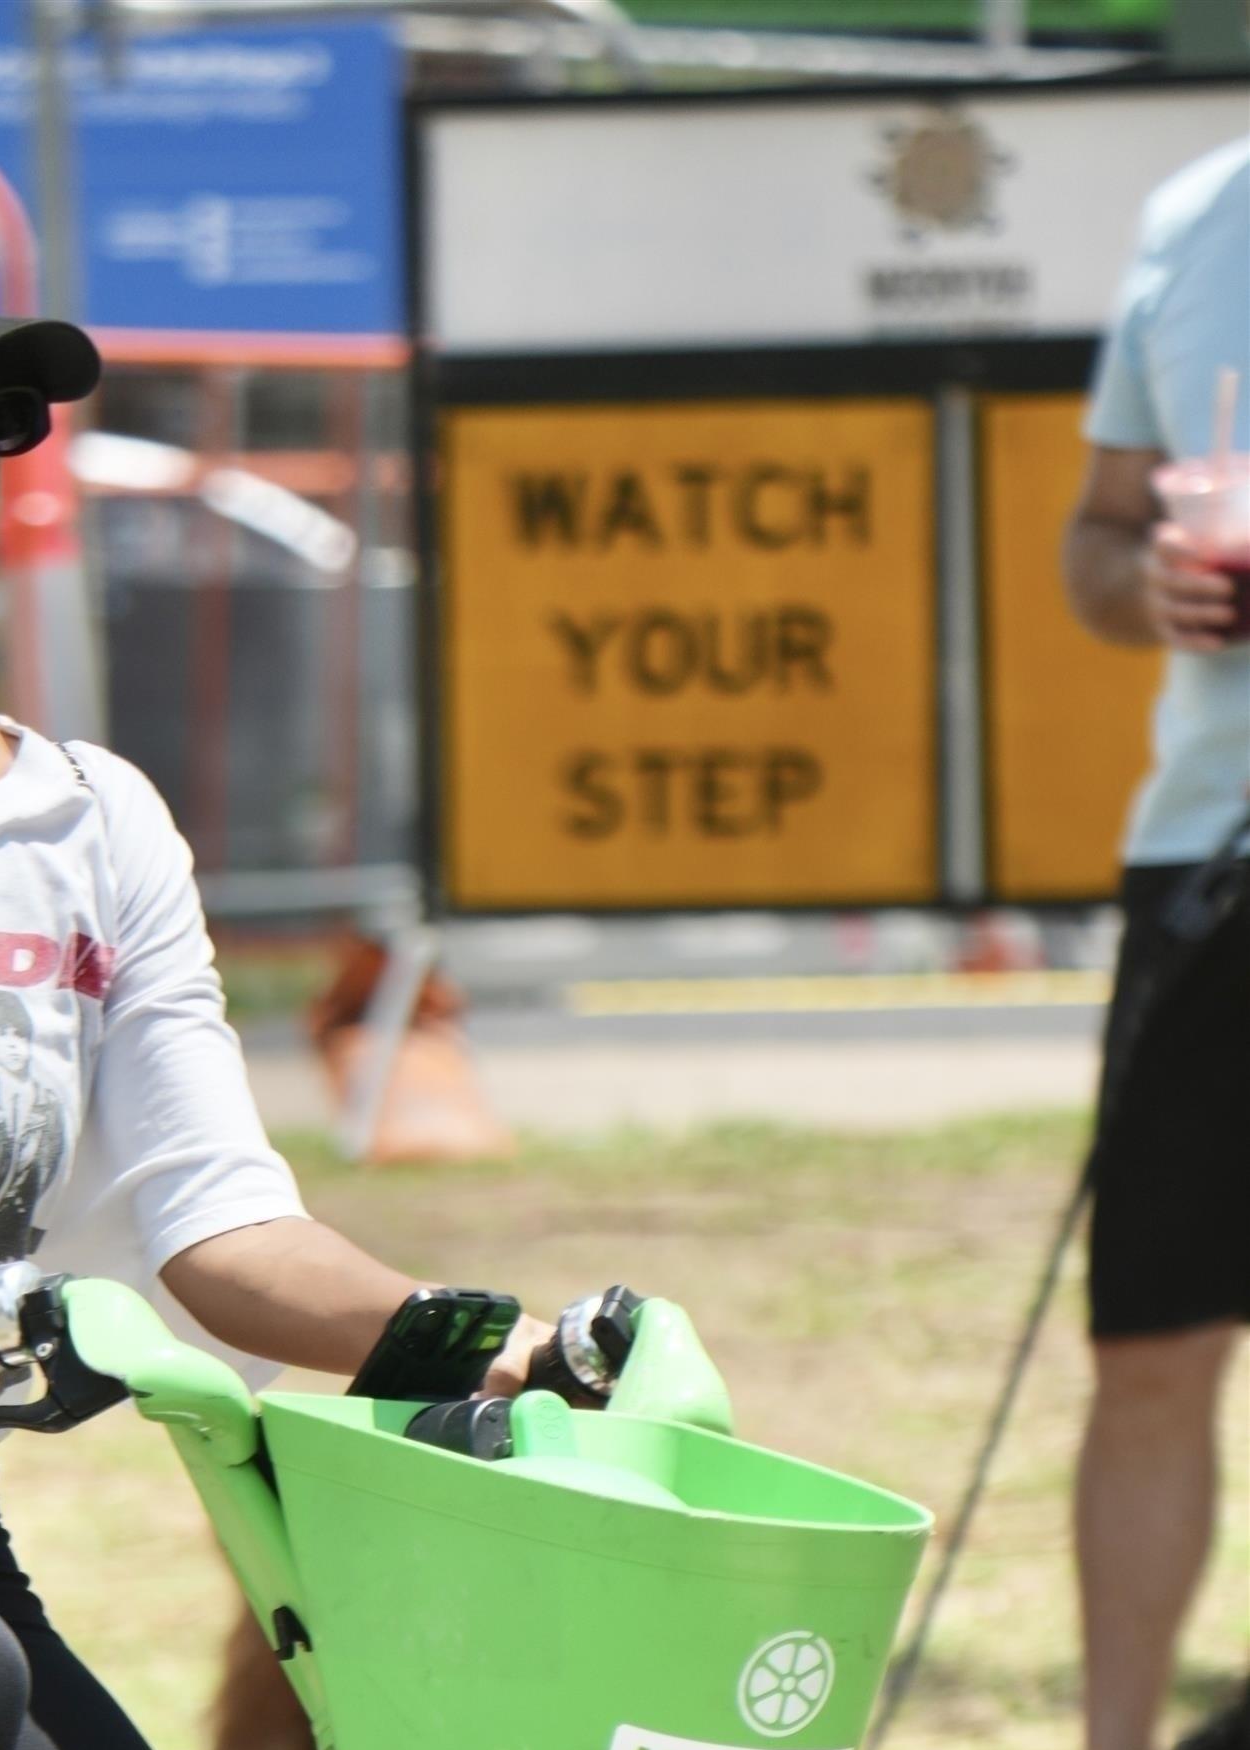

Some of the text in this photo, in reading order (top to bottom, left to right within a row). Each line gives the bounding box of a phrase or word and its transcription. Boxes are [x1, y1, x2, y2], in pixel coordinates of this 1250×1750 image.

[507, 464, 870, 552] WATCH
[552, 605, 836, 697] YOUR
[558, 746, 825, 840] STEP
